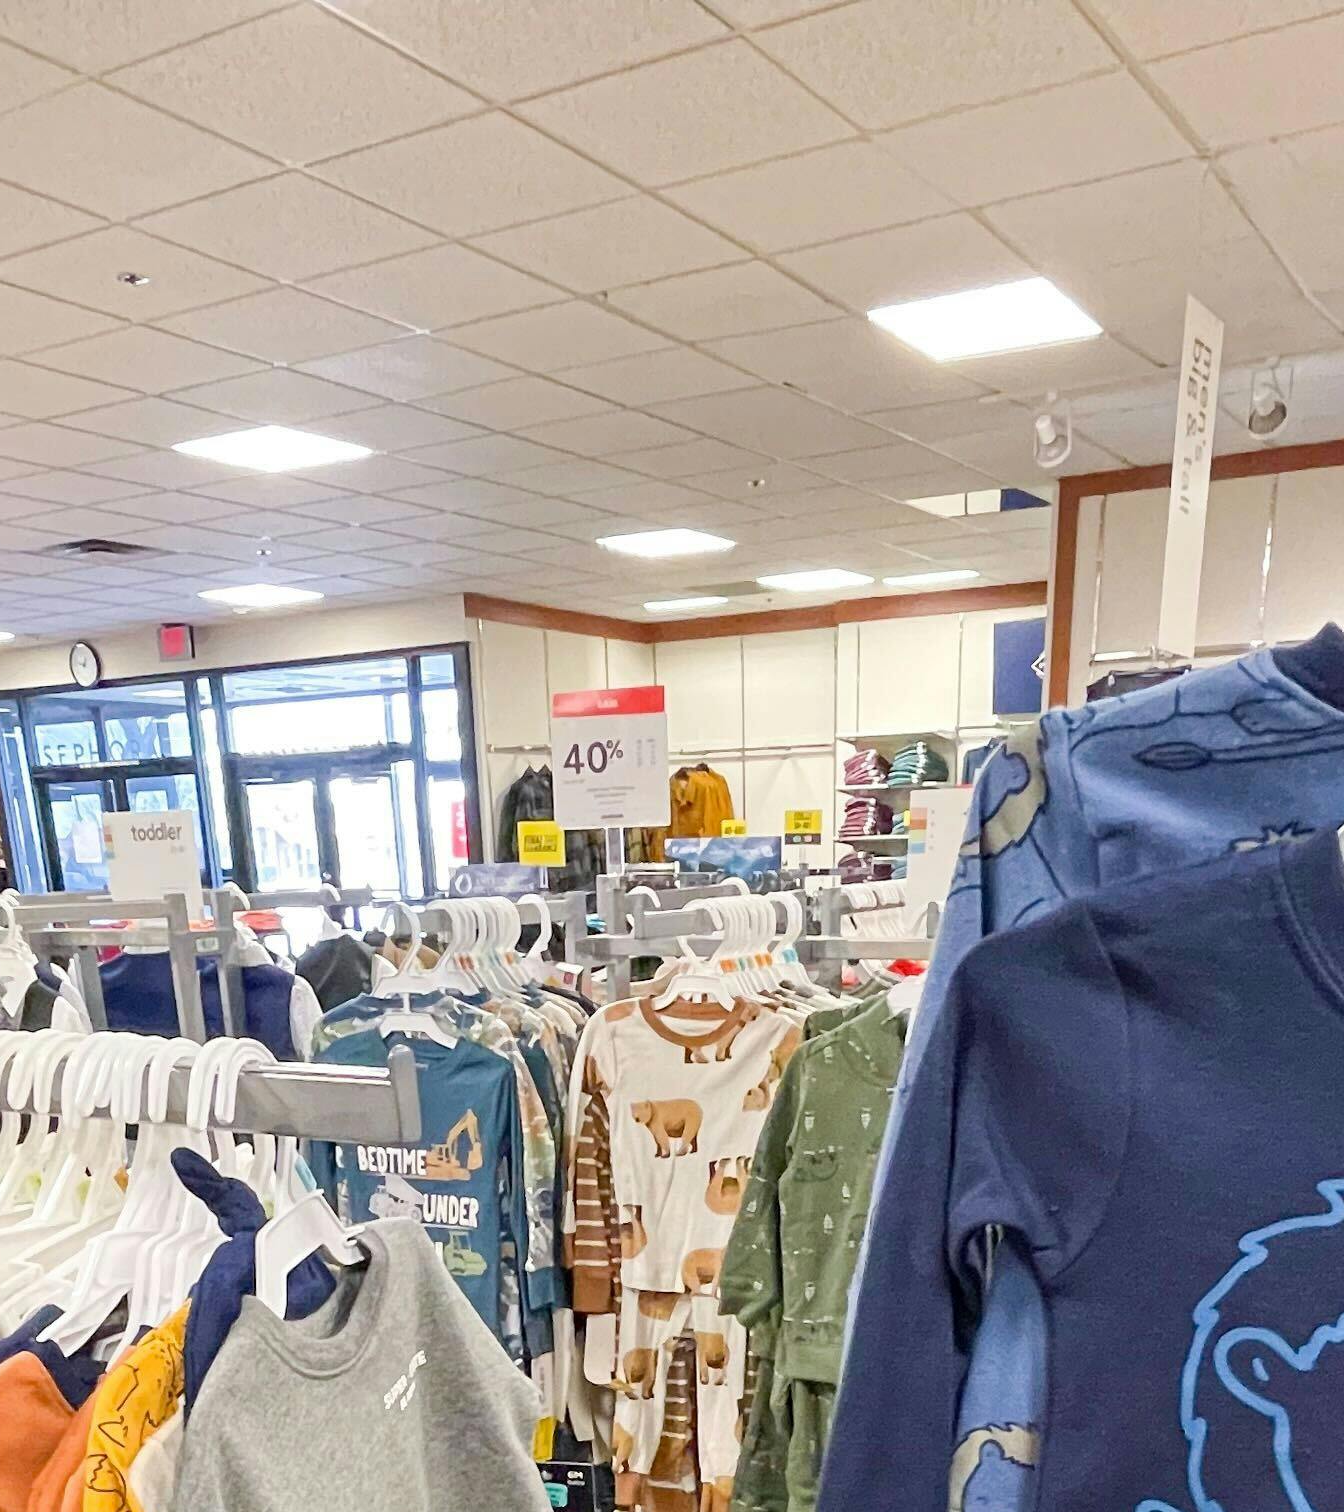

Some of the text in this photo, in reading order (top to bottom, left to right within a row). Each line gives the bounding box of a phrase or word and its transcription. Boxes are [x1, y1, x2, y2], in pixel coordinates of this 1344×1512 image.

[562, 739, 624, 775] 40%
[130, 821, 183, 842] toddler
[357, 1144, 427, 1176] BEDTIME
[422, 1193, 480, 1228] UNDER
